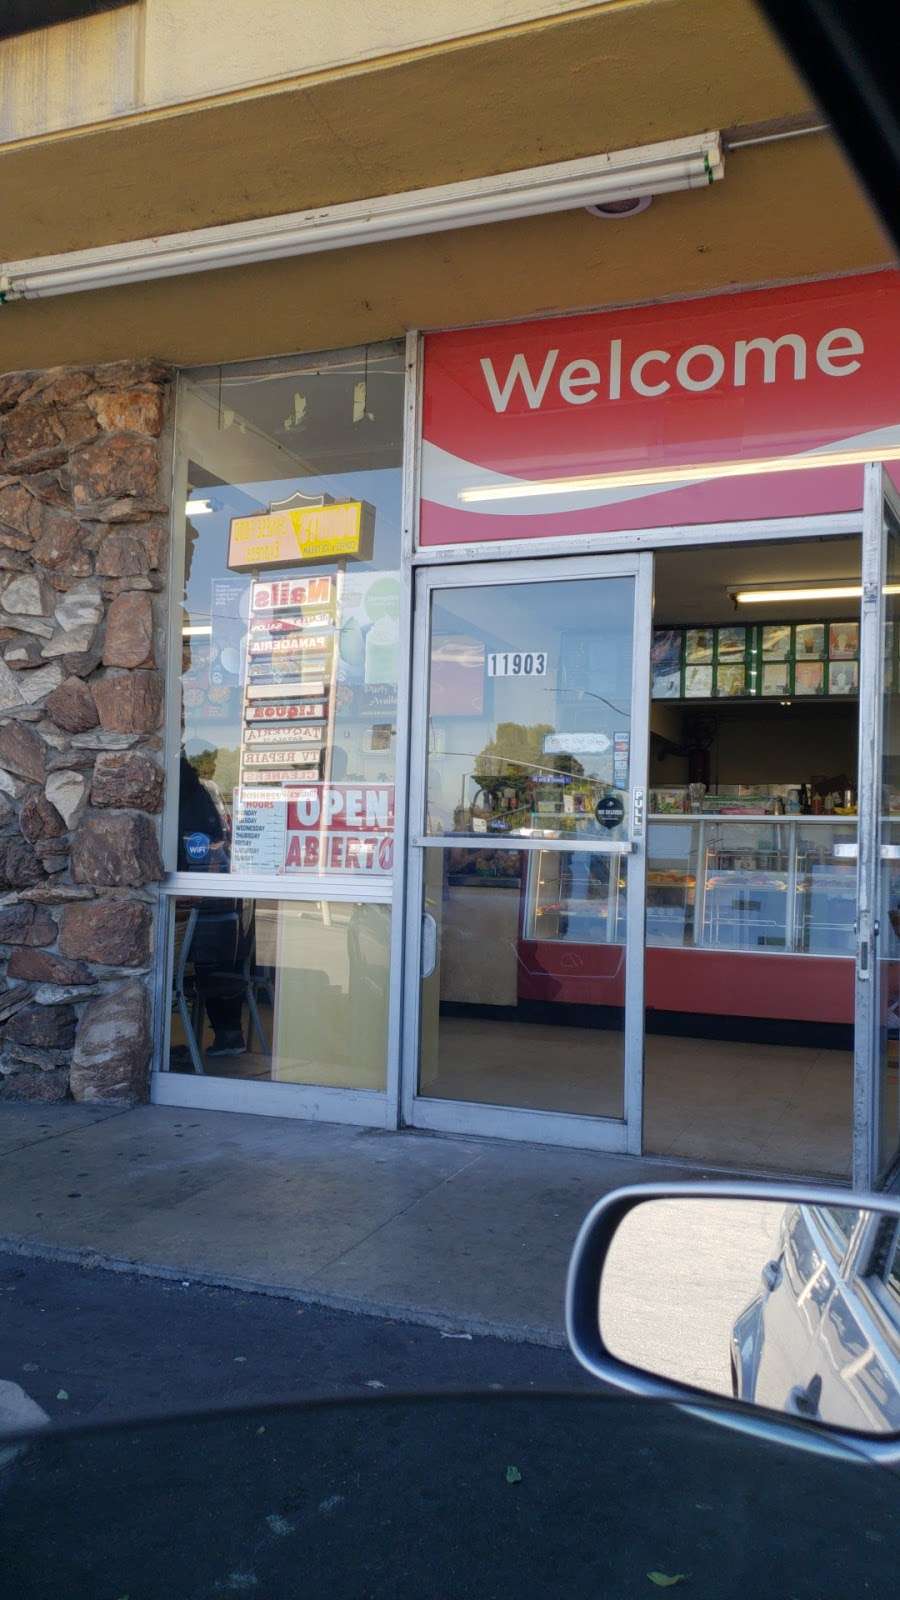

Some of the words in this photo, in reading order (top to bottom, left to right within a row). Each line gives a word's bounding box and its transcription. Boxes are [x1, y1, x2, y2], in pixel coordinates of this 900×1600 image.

[480, 327, 864, 413] Welcome
[491, 653, 545, 675] 11903
[246, 801, 274, 809] HOURS
[296, 789, 389, 826] OPEN
[634, 790, 643, 825] PULL
[285, 835, 394, 870] ABIERTO
